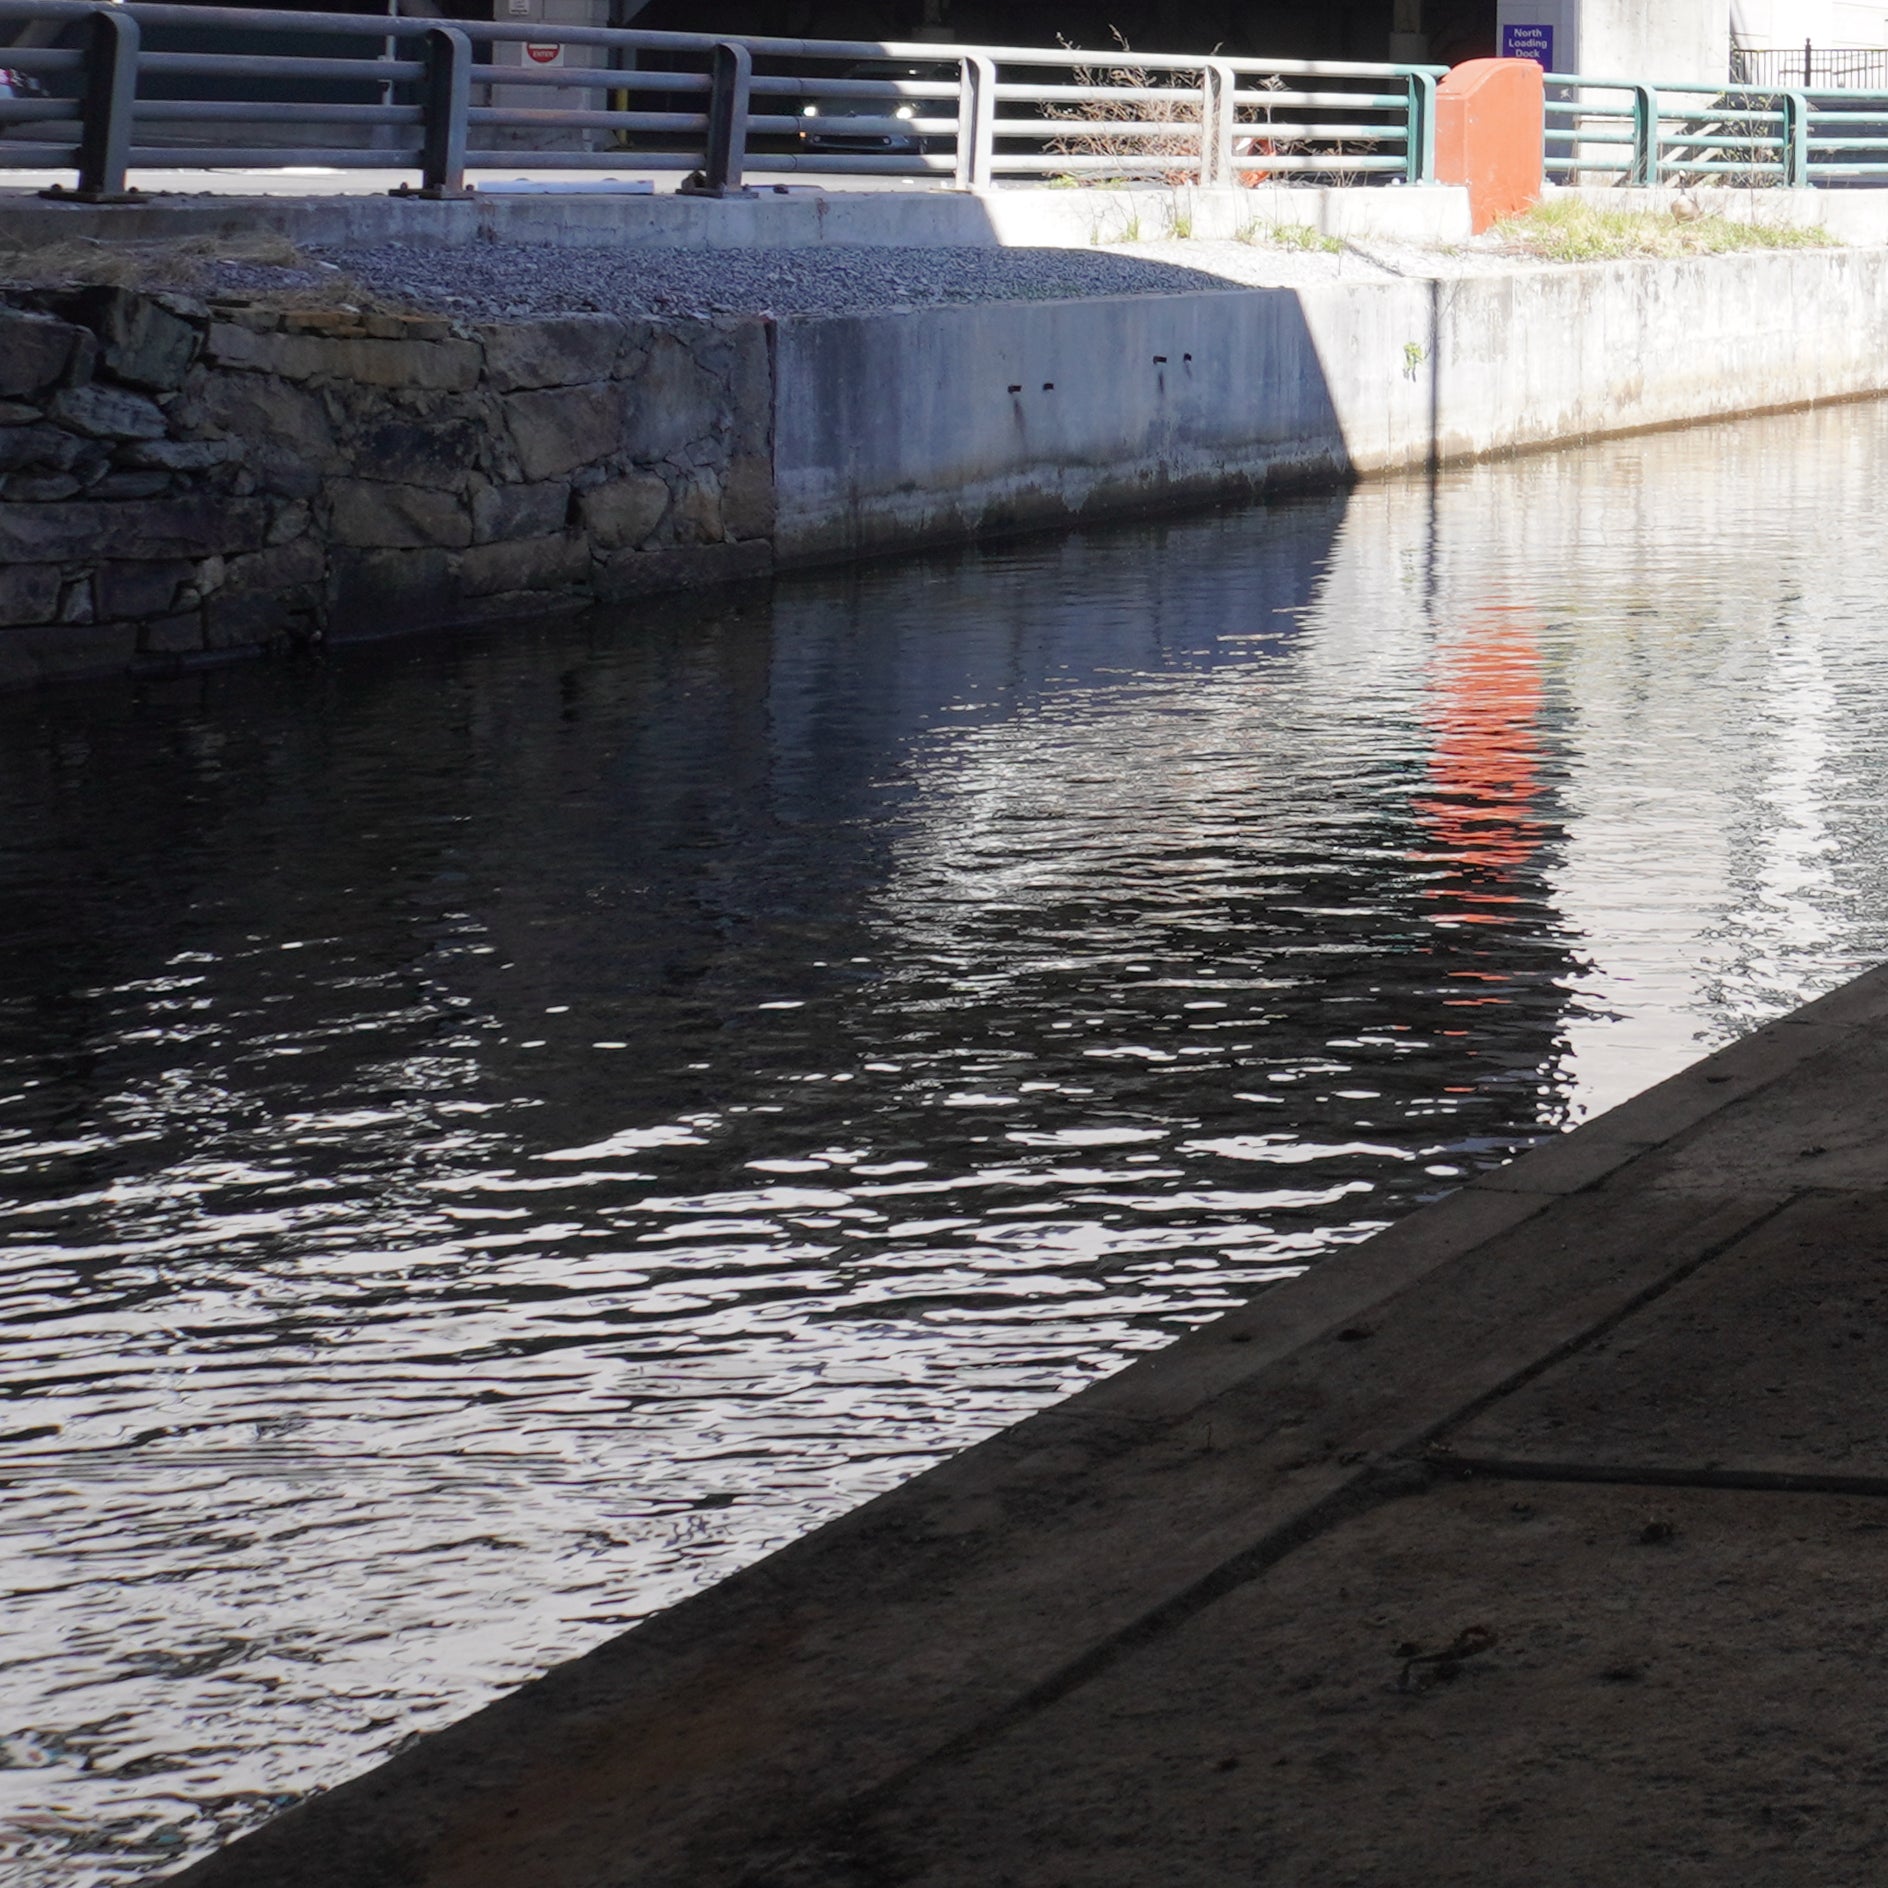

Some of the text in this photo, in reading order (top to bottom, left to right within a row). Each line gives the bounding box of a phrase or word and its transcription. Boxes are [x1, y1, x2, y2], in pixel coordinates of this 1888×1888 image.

[1513, 28, 1542, 38] North
[1508, 38, 1548, 50] Loading
[1515, 49, 1540, 58] Dock
